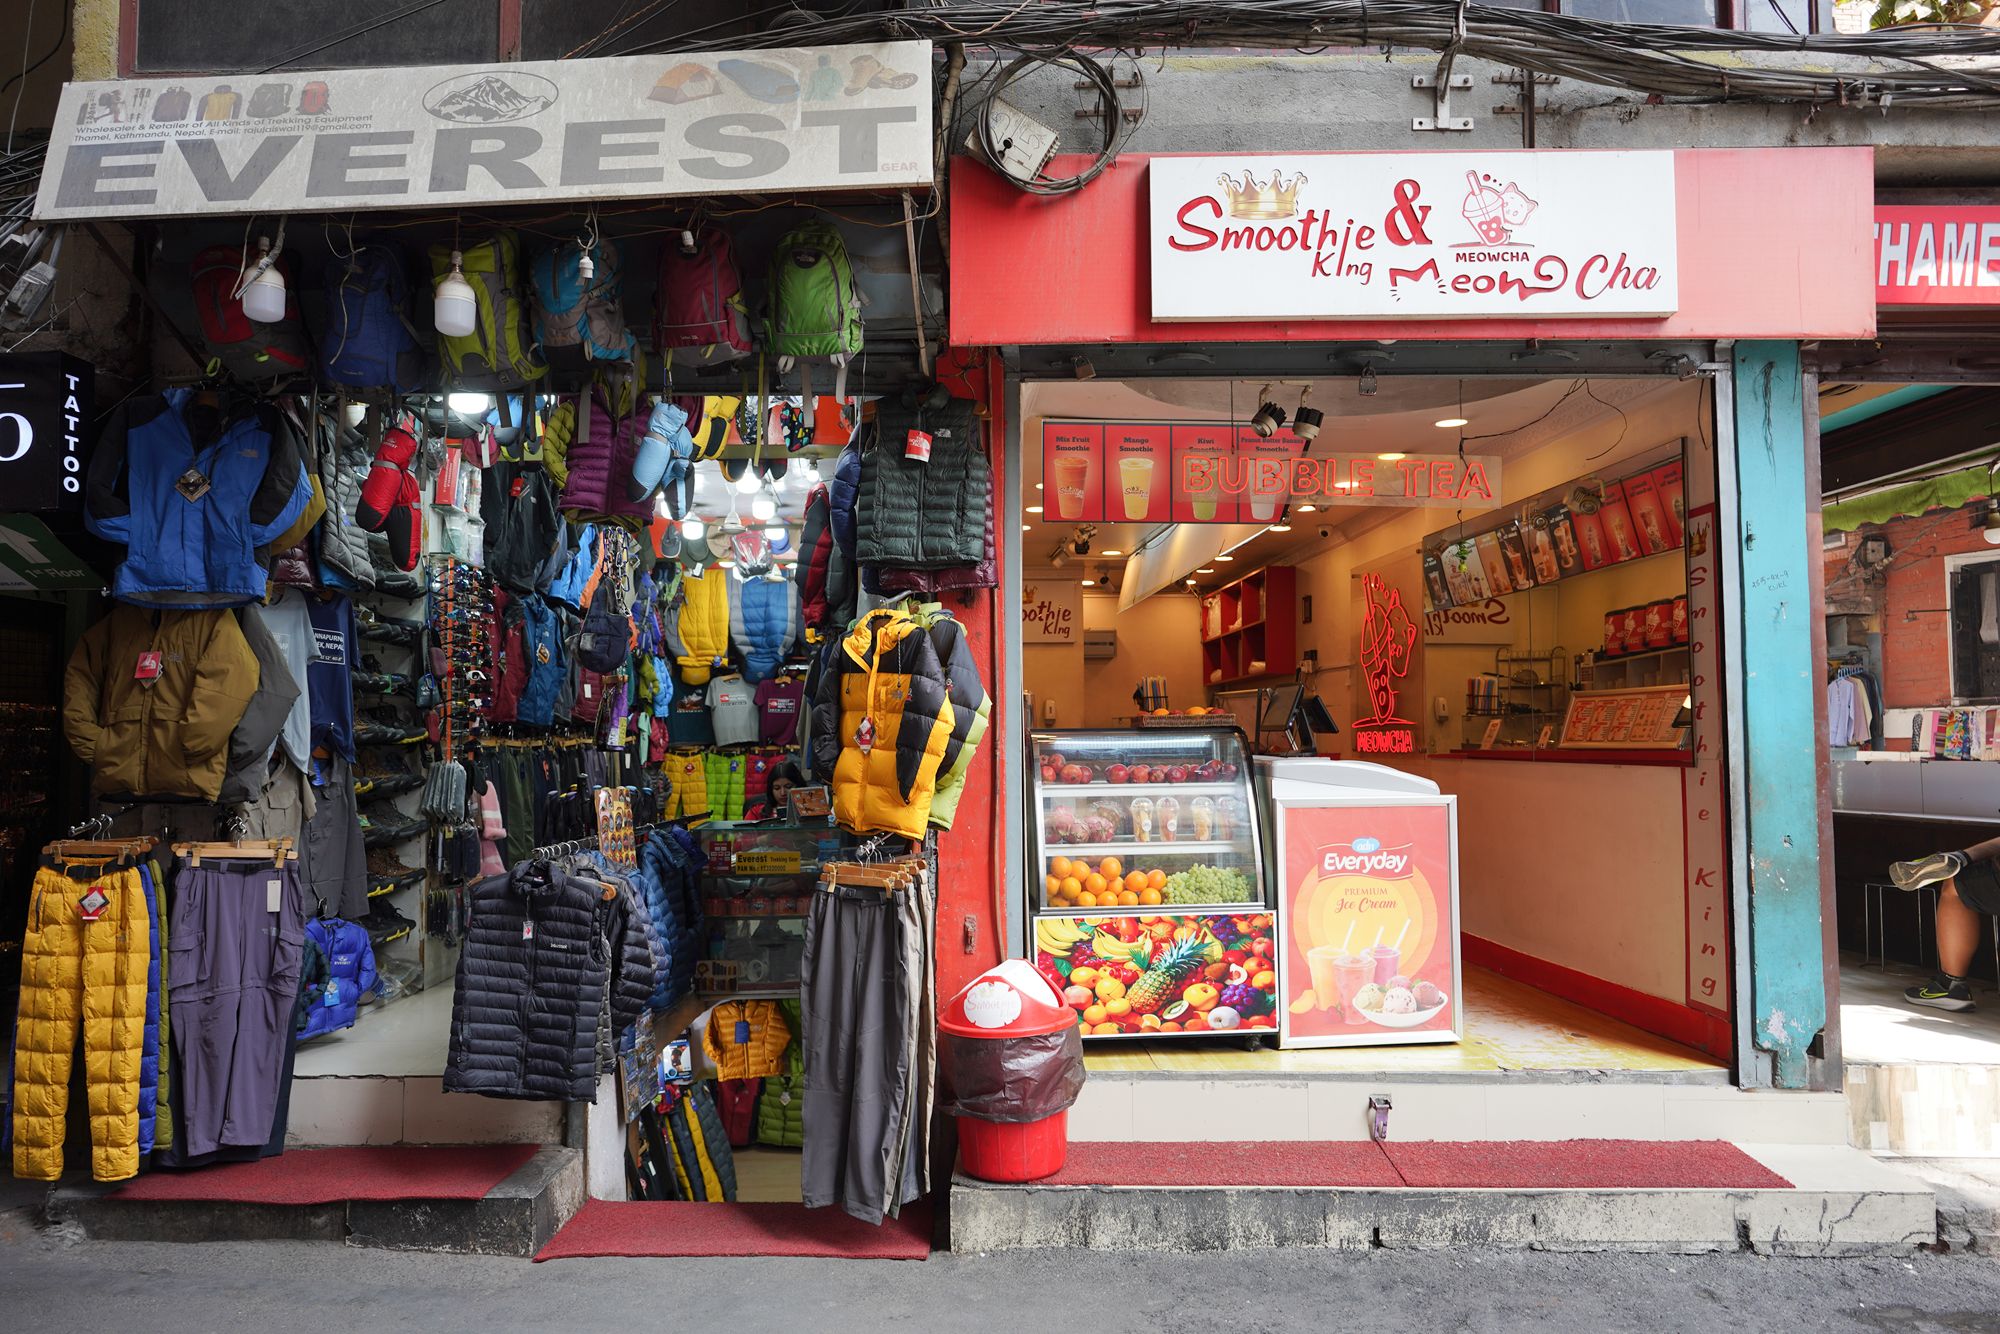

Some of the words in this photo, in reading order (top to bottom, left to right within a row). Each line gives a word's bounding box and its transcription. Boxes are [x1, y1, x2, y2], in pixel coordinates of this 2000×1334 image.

[76, 126, 135, 134] Wholesaler
[149, 122, 189, 130] Retailer
[222, 119, 251, 127] Kinds
[254, 118, 265, 126] of
[268, 116, 312, 125] Trekking
[315, 115, 373, 123] Equipment
[54, 106, 917, 209] EVEREST
[880, 161, 918, 172] GEAR
[1168, 195, 1375, 252] Smoothie
[1384, 179, 1433, 246] &
[1456, 252, 1529, 262] MEOWCHA
[1874, 222, 2000, 287] HAME
[1575, 252, 1661, 300] Cha
[63, 373, 80, 493] TATTOO
[1182, 455, 1375, 497] BUBBLE
[1396, 460, 1494, 500] TEA
[45, 567, 86, 578] Floor
[1689, 566, 1711, 823] Smoothie
[1357, 730, 1413, 753] MEOWCHA
[737, 855, 768, 863] Everest
[1324, 852, 1408, 873] Everyday
[1335, 898, 1356, 913] Ice
[1358, 897, 1397, 913] Cream
[1344, 888, 1388, 896] PREMIUM
[1694, 868, 1717, 997] King
